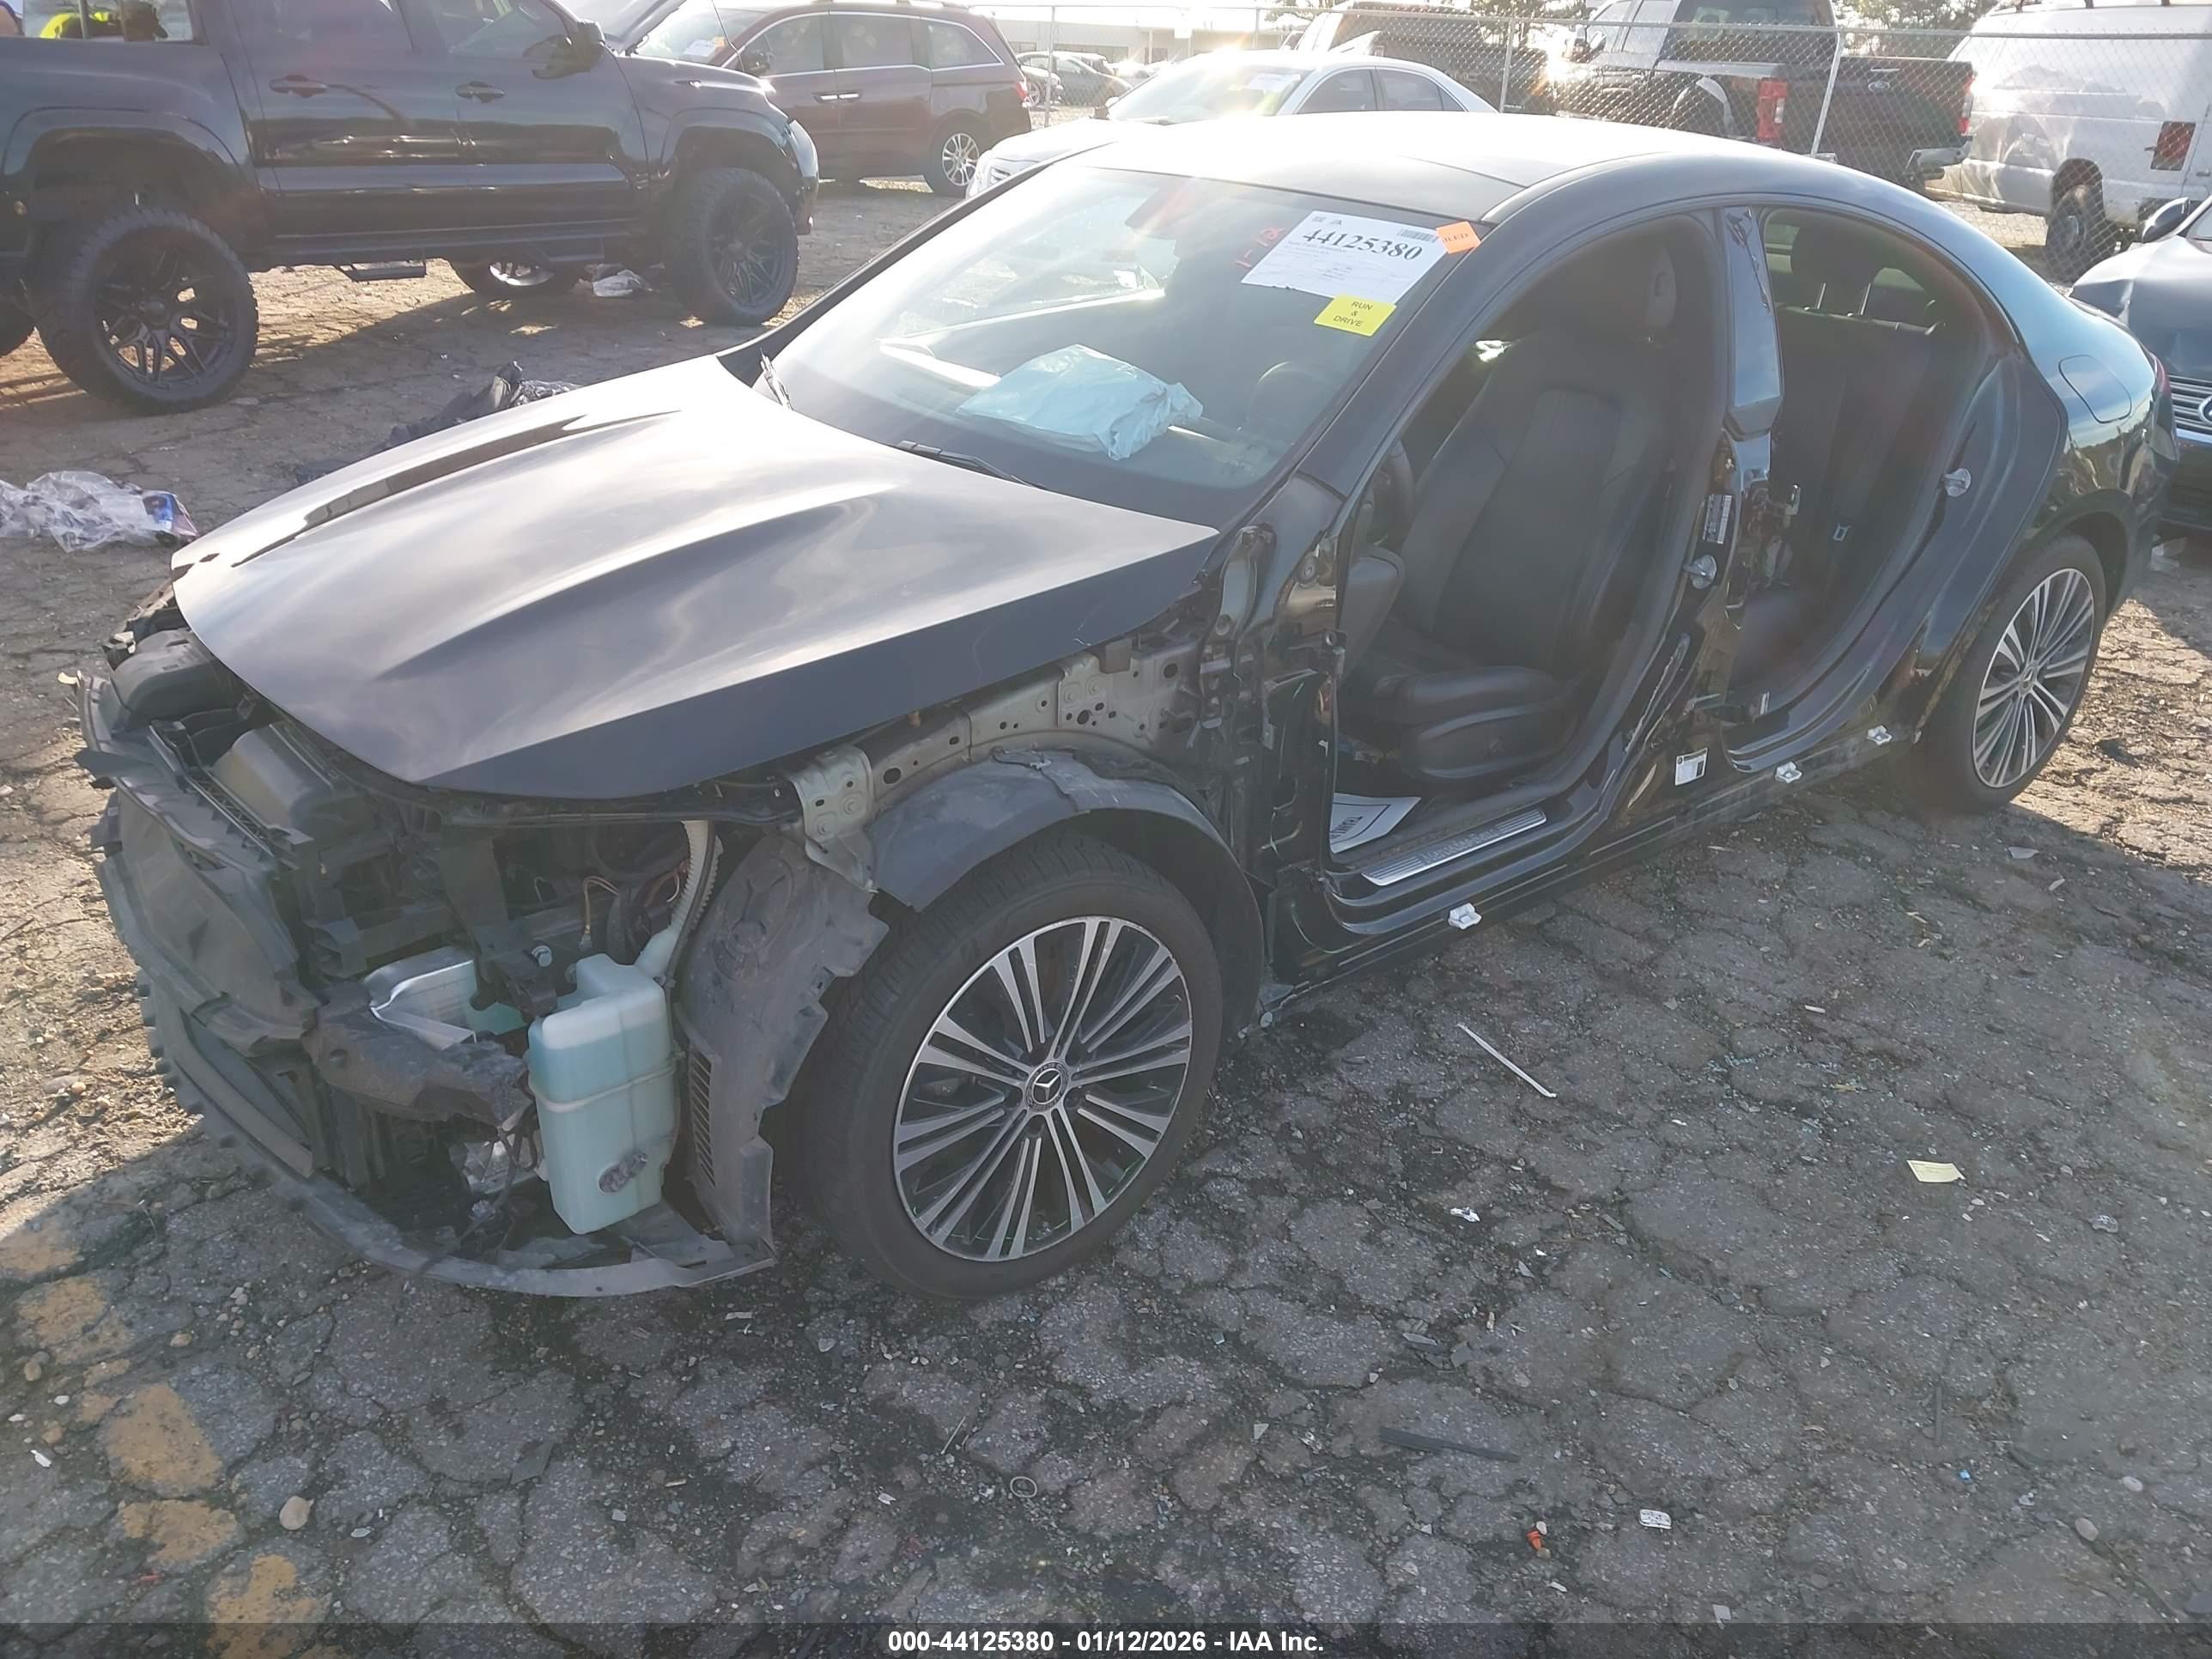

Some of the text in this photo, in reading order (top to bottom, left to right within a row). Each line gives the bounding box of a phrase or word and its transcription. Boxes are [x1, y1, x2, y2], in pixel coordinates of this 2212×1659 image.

[1303, 228, 1423, 261] 44125380
[1351, 301, 1373, 311] RUN
[1333, 315, 1364, 328] DRIVE
